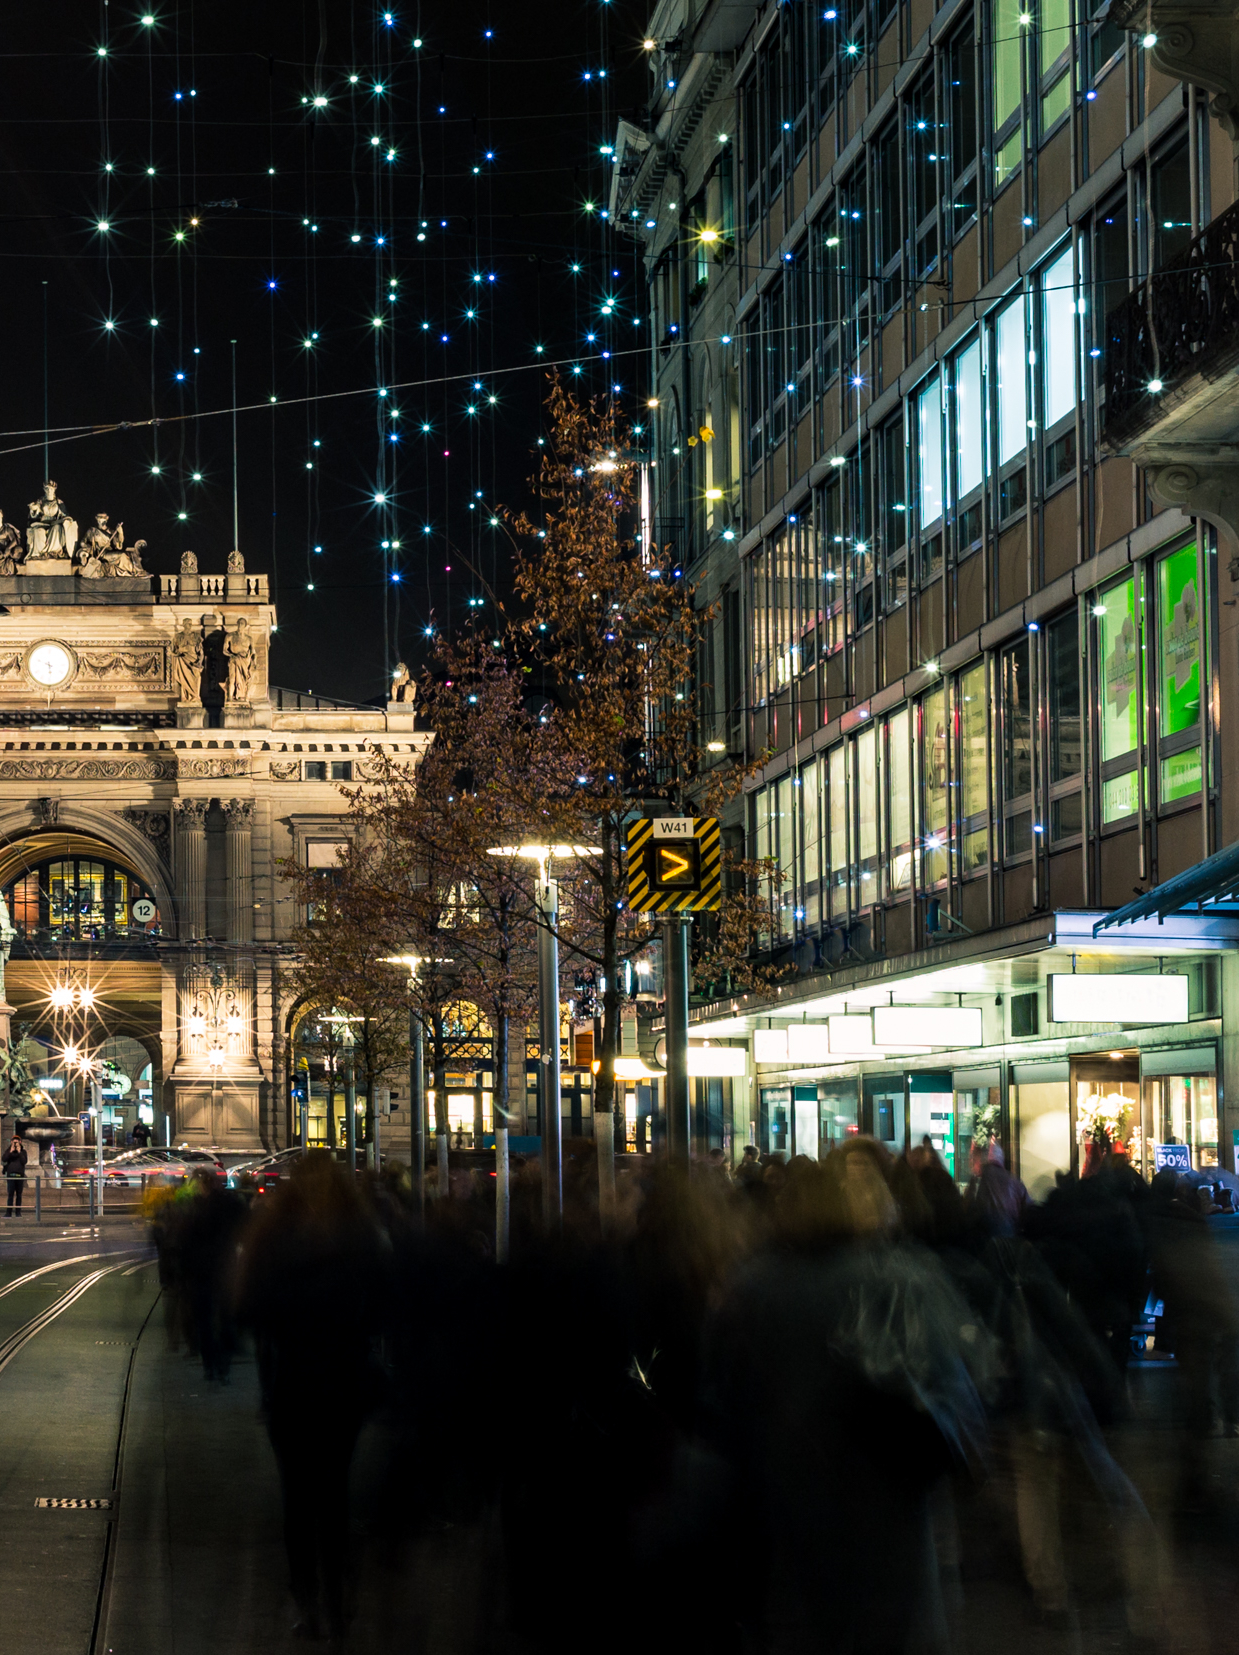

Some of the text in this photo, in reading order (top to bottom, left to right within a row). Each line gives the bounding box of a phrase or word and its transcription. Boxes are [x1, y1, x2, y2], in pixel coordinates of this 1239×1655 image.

[661, 822, 688, 833] W41
[137, 905, 151, 916] 12
[1158, 1154, 1188, 1167] 50%
